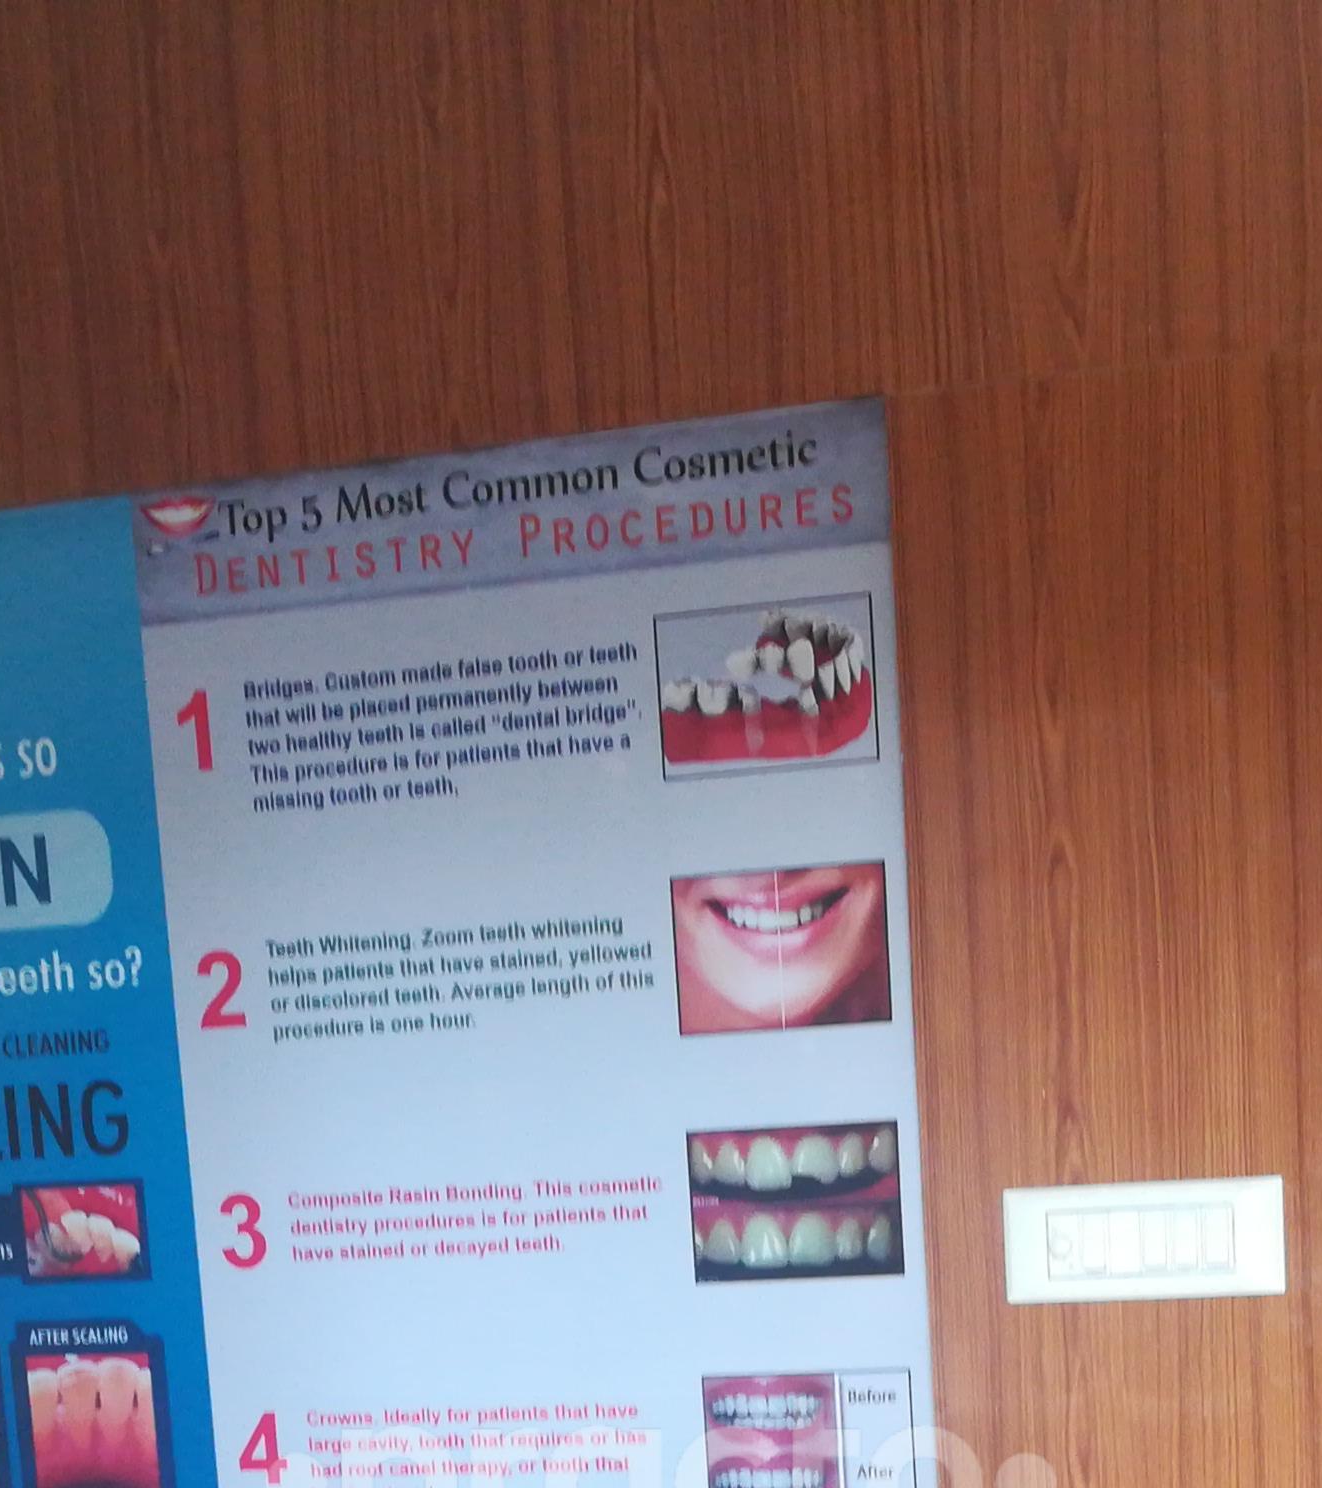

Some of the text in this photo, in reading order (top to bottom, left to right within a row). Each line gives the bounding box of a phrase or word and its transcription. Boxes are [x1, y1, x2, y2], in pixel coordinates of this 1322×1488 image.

[218, 430, 818, 544] Top 5 Most Common Cosmetic
[193, 482, 856, 596] DENTISTRY PROCEDURES
[243, 642, 638, 700] Bridges. Custom made false tooth or teeth
[246, 675, 619, 728] that will be placed permanently between
[176, 689, 214, 771] 1
[249, 737, 281, 755] two
[286, 729, 352, 754] healthy
[358, 723, 404, 744] teeth
[409, 722, 425, 739] is
[432, 715, 486, 737] called
[18, 735, 58, 777] so
[250, 733, 631, 784] This procedure is for patients that have a
[266, 937, 315, 959] Teeth
[421, 926, 474, 948] Zoom
[479, 920, 525, 943] teeth
[531, 915, 624, 941] whitening
[88, 945, 142, 990] so?
[268, 967, 318, 988] helps
[322, 960, 394, 986] patients
[400, 956, 436, 977] that
[440, 952, 483, 974] have
[569, 942, 652, 969] yellowed
[197, 948, 247, 1030] 2
[271, 995, 289, 1013] or
[295, 986, 389, 1012] discolored
[450, 980, 525, 1002] Average
[531, 974, 589, 999] length
[596, 970, 615, 991] of
[620, 968, 654, 989] this
[1, 1029, 110, 1061] CLEANING
[273, 1018, 365, 1043] procedure
[370, 1017, 385, 1036] is
[390, 1013, 425, 1032] one
[220, 1191, 268, 1270] 3
[291, 1203, 649, 1237] dentistry procedures is for patients that
[292, 1243, 335, 1262] have
[339, 1238, 405, 1260] stained
[410, 1239, 430, 1256] or
[435, 1236, 509, 1261] decayed
[29, 1324, 128, 1347] AFTER SCALING
[383, 1406, 440, 1427] Ideally
[446, 1406, 472, 1423] for
[477, 1406, 549, 1427] patients
[556, 1404, 590, 1422] that
[595, 1403, 639, 1420] have
[848, 1389, 897, 1405] Before
[238, 1410, 287, 1486] 4
[308, 1434, 352, 1454] large
[419, 1431, 464, 1449] tooth
[471, 1430, 505, 1449] that
[590, 1430, 611, 1446] or
[614, 1428, 647, 1446] has
[311, 1460, 342, 1479] had
[347, 1458, 382, 1477] root
[518, 1457, 538, 1475] or
[542, 1457, 590, 1474] tooth
[596, 1456, 629, 1473] that
[857, 1463, 895, 1480] After
